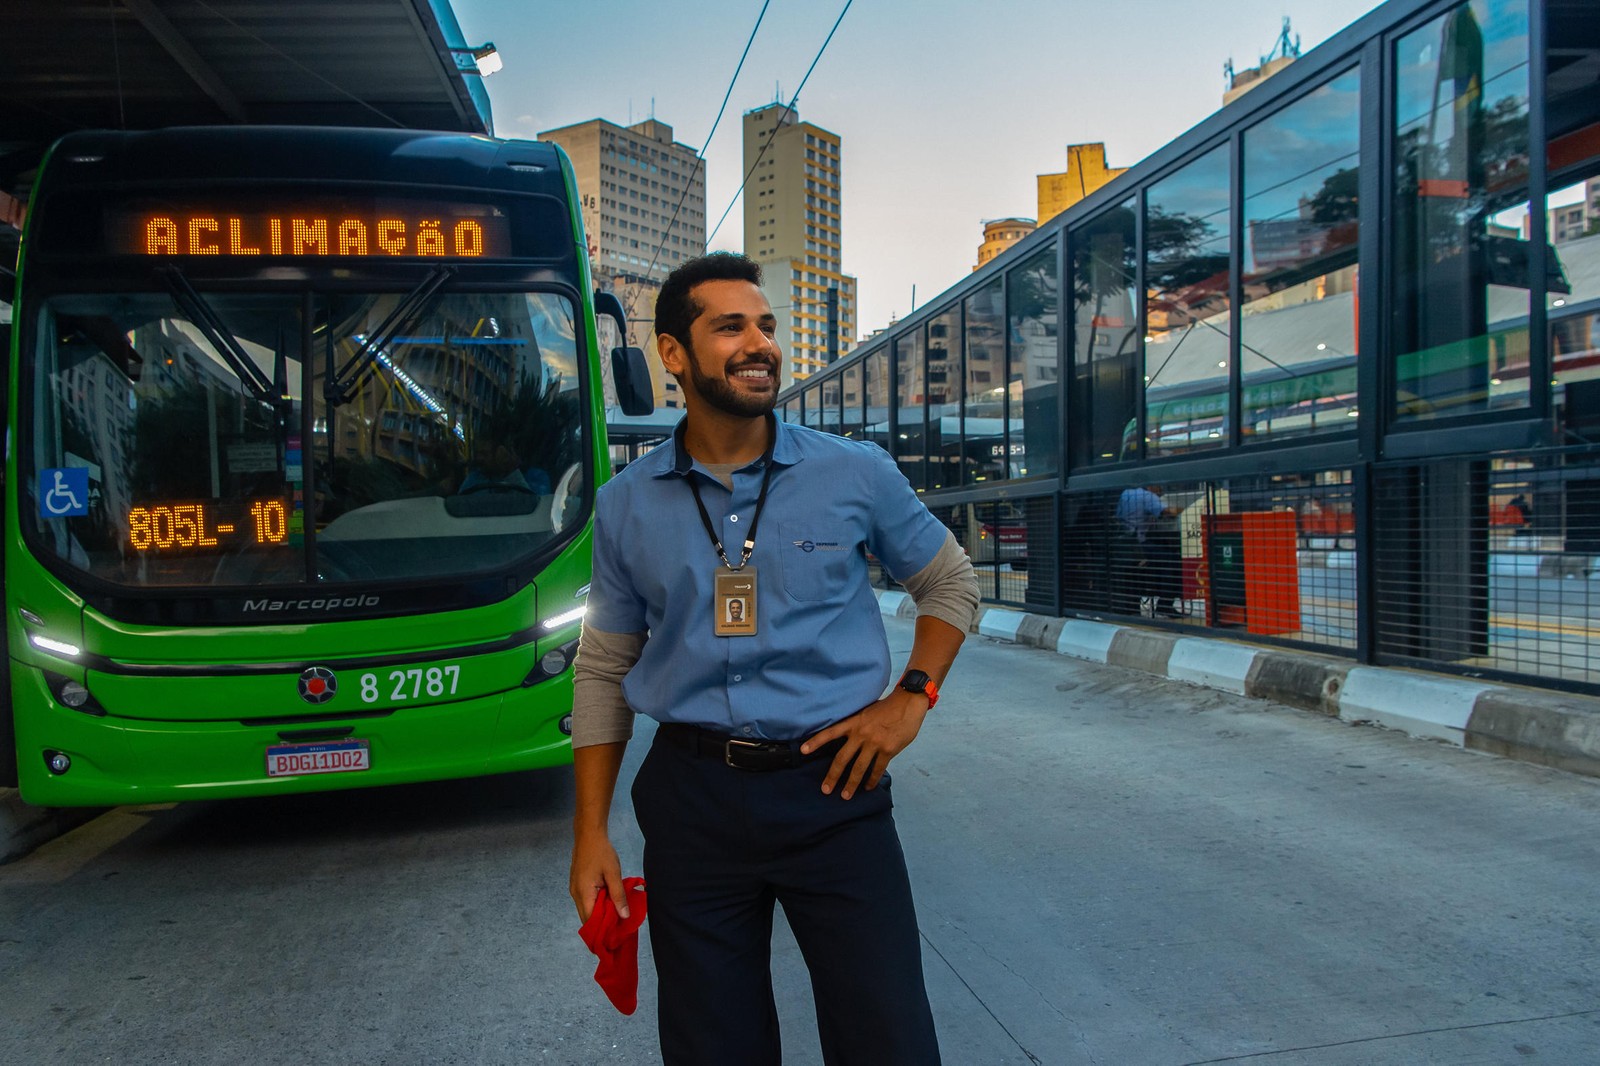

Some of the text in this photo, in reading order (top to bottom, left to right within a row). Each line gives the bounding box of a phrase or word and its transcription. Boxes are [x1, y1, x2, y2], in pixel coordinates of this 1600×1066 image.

[147, 217, 483, 256] ACLIMAÇÃO
[251, 501, 286, 543] 10
[242, 594, 380, 612] Marcopolo
[360, 665, 460, 703] 8 2787
